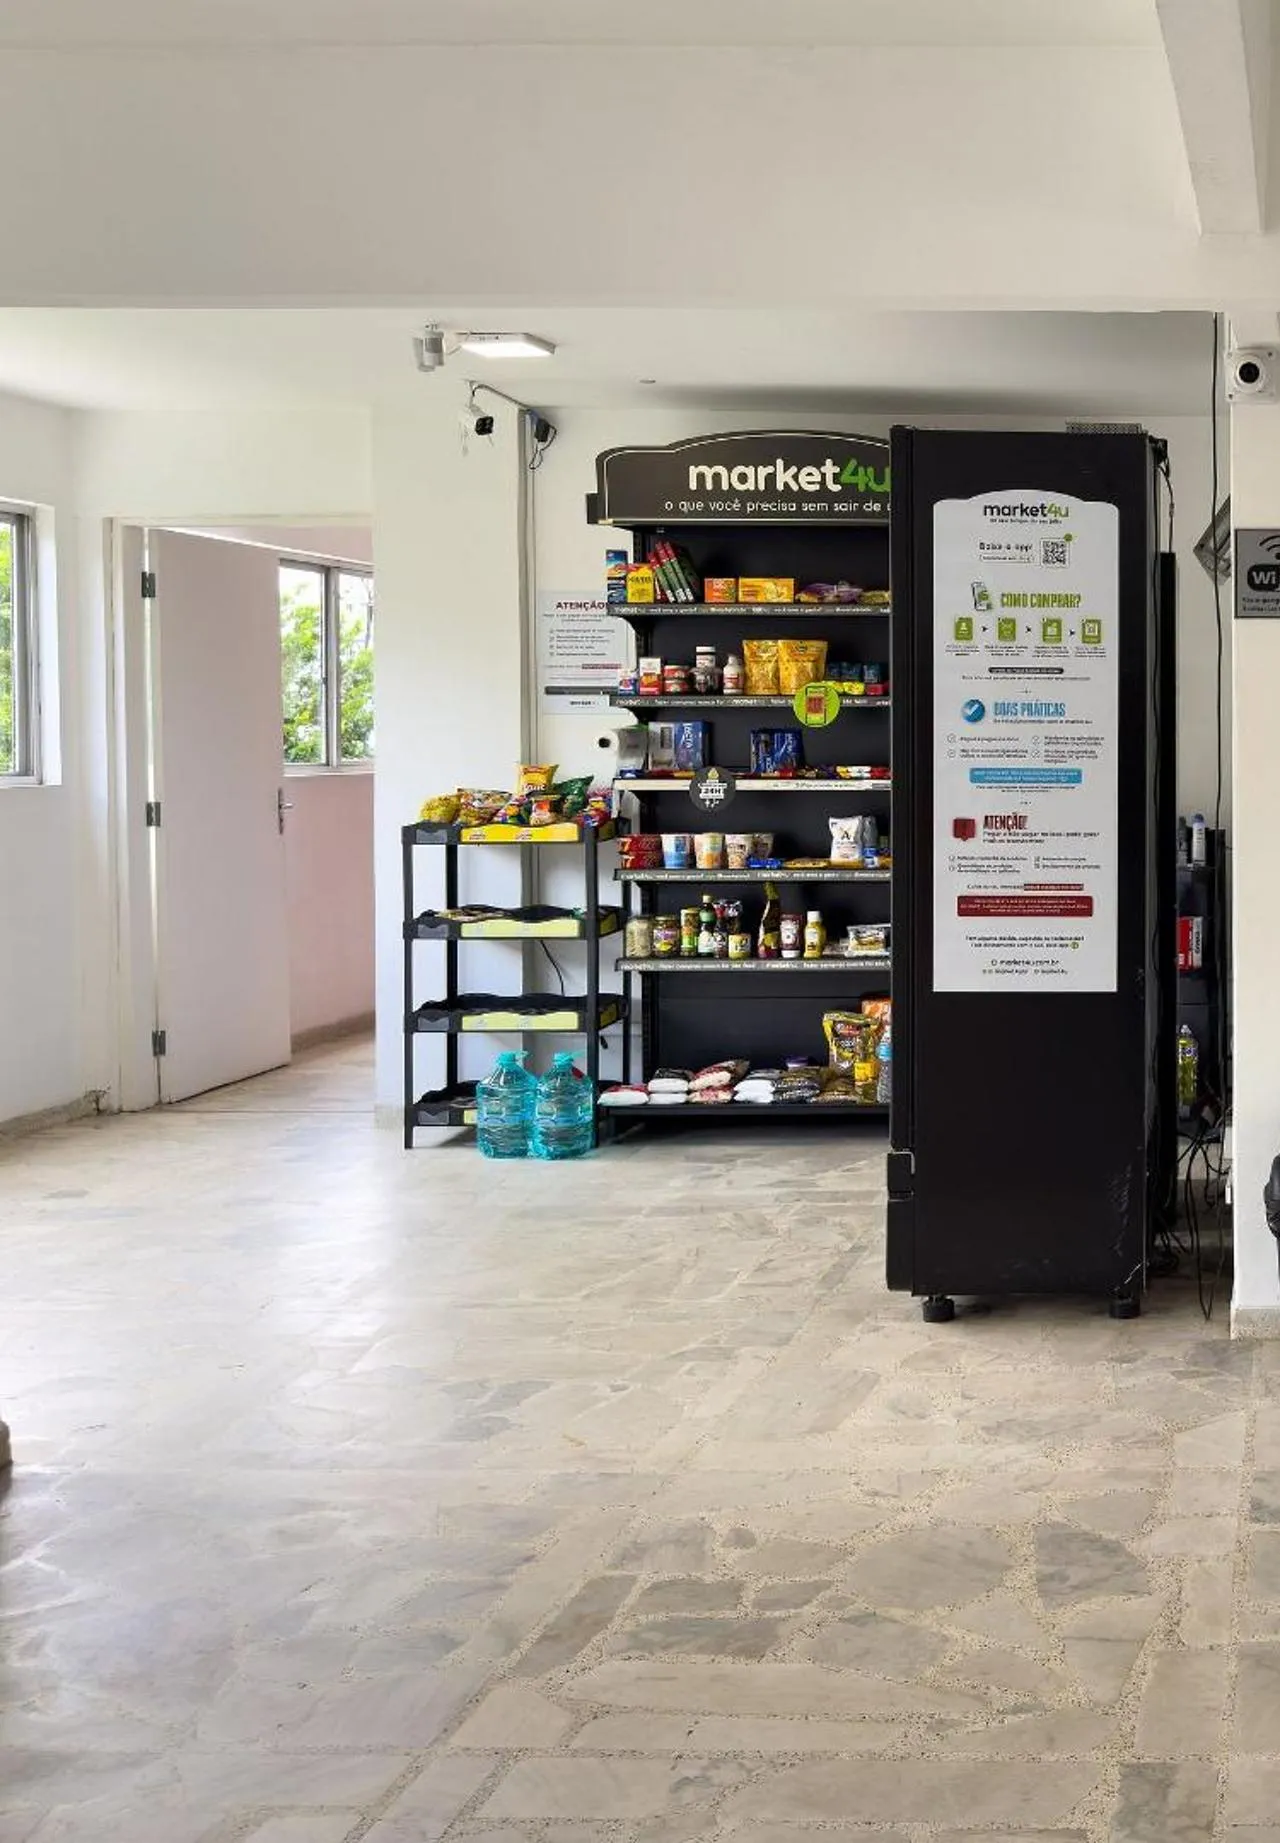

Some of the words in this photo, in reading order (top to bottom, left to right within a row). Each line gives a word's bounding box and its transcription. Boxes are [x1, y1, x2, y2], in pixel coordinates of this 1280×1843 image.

[689, 458, 890, 493] market4u
[665, 501, 673, 511] o
[679, 500, 704, 513] que
[709, 498, 740, 512] você
[747, 500, 797, 513] precisa
[802, 501, 828, 512] sem
[834, 499, 857, 512] sair
[863, 499, 881, 512] de
[983, 503, 1069, 518] market4u
[1252, 571, 1276, 584] Wi
[1020, 700, 1066, 716] PRÁTICAS
[983, 812, 1028, 831] ATENÇÃO!
